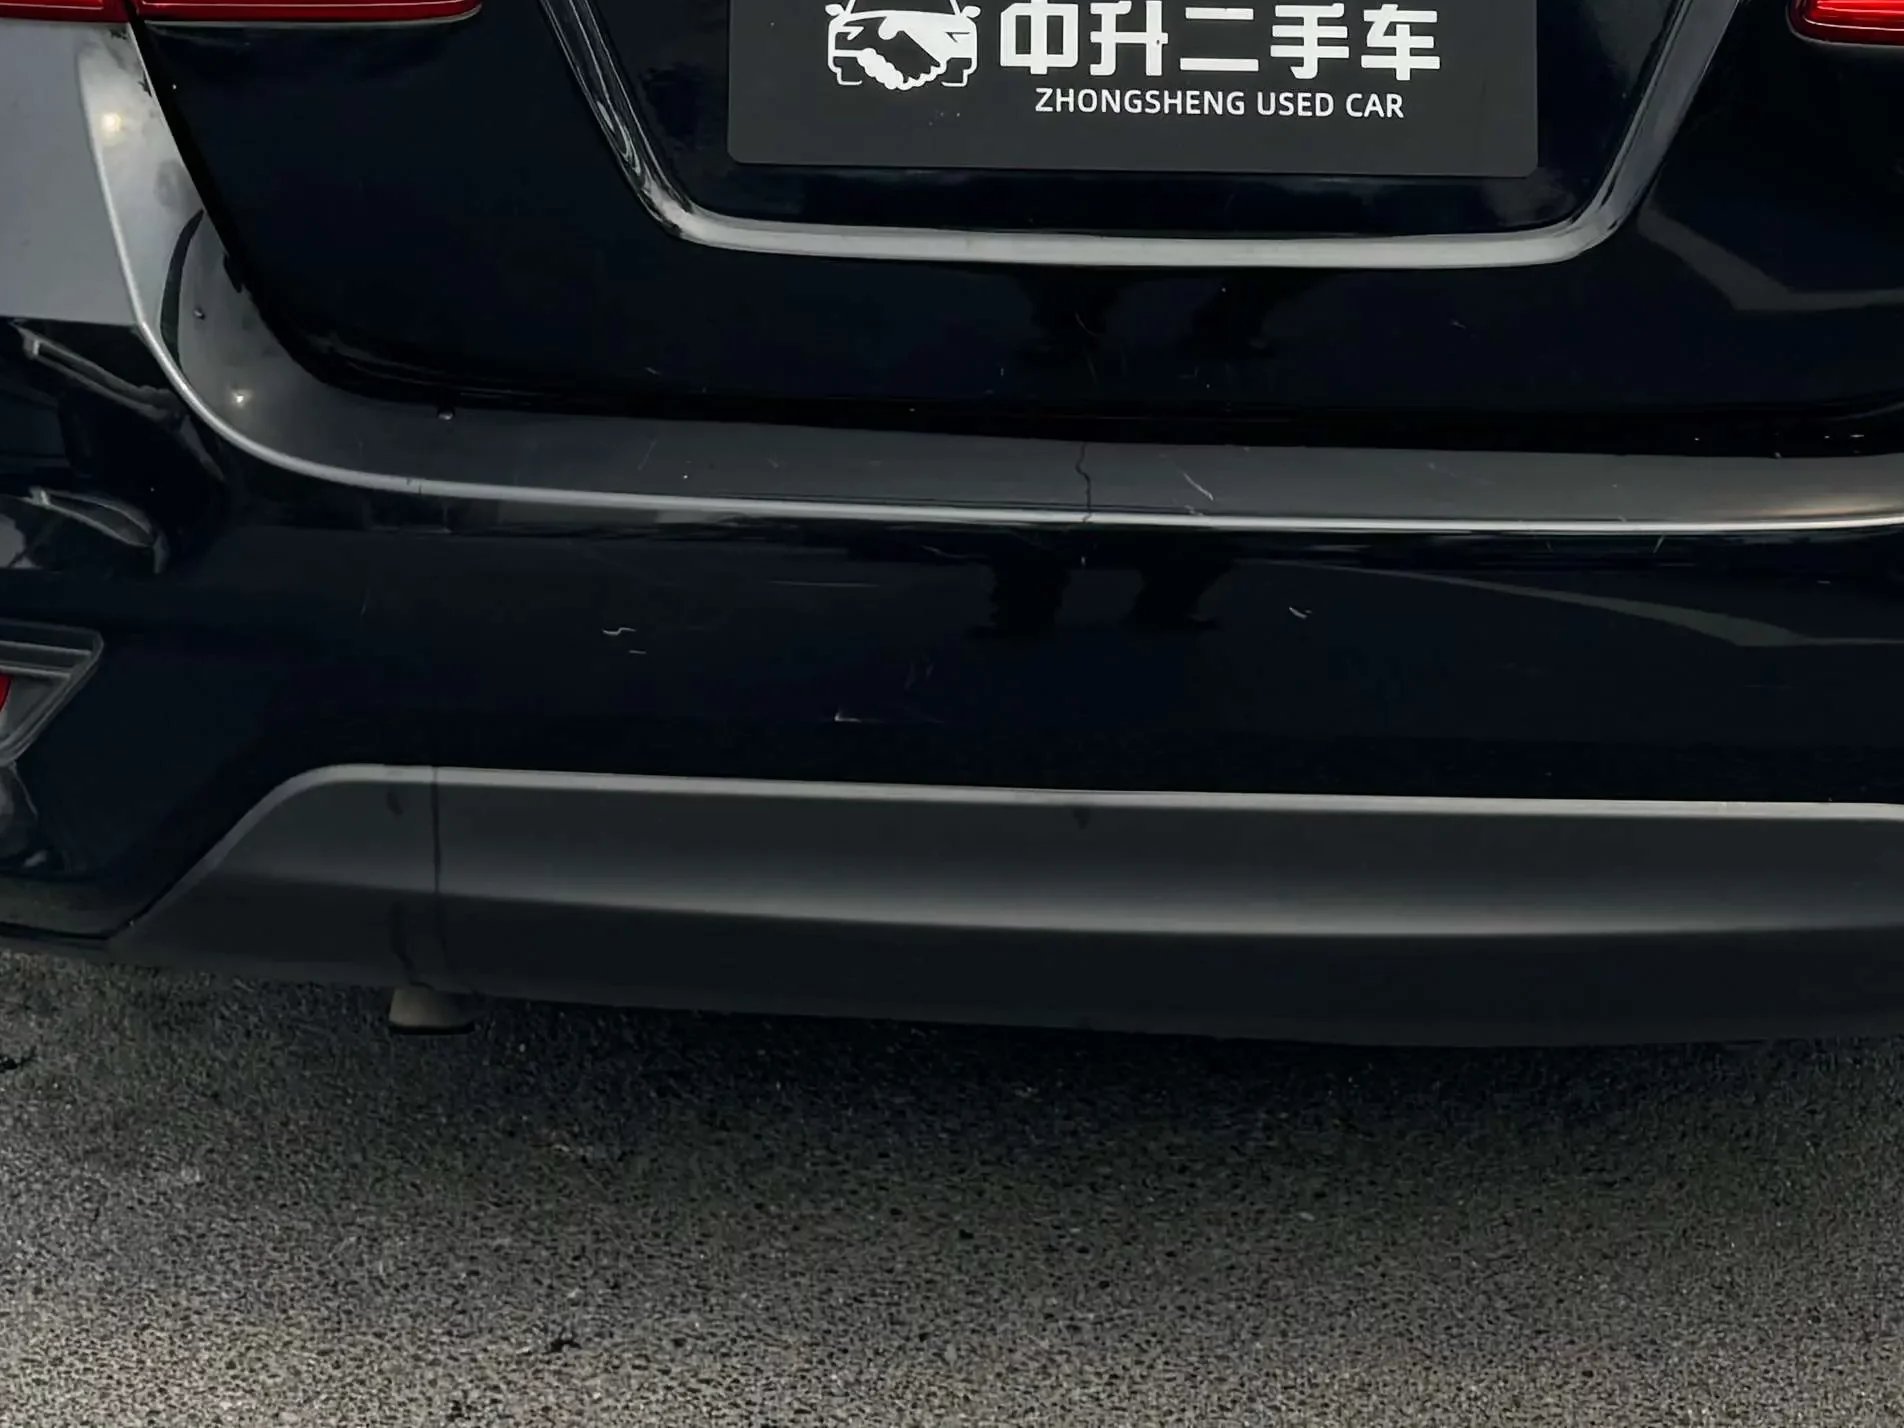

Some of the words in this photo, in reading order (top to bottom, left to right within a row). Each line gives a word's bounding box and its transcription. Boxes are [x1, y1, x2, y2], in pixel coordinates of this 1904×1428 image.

[1035, 87, 1246, 116] ZHONGSHENG
[1258, 92, 1335, 117] USED
[1345, 93, 1405, 118] CAR
